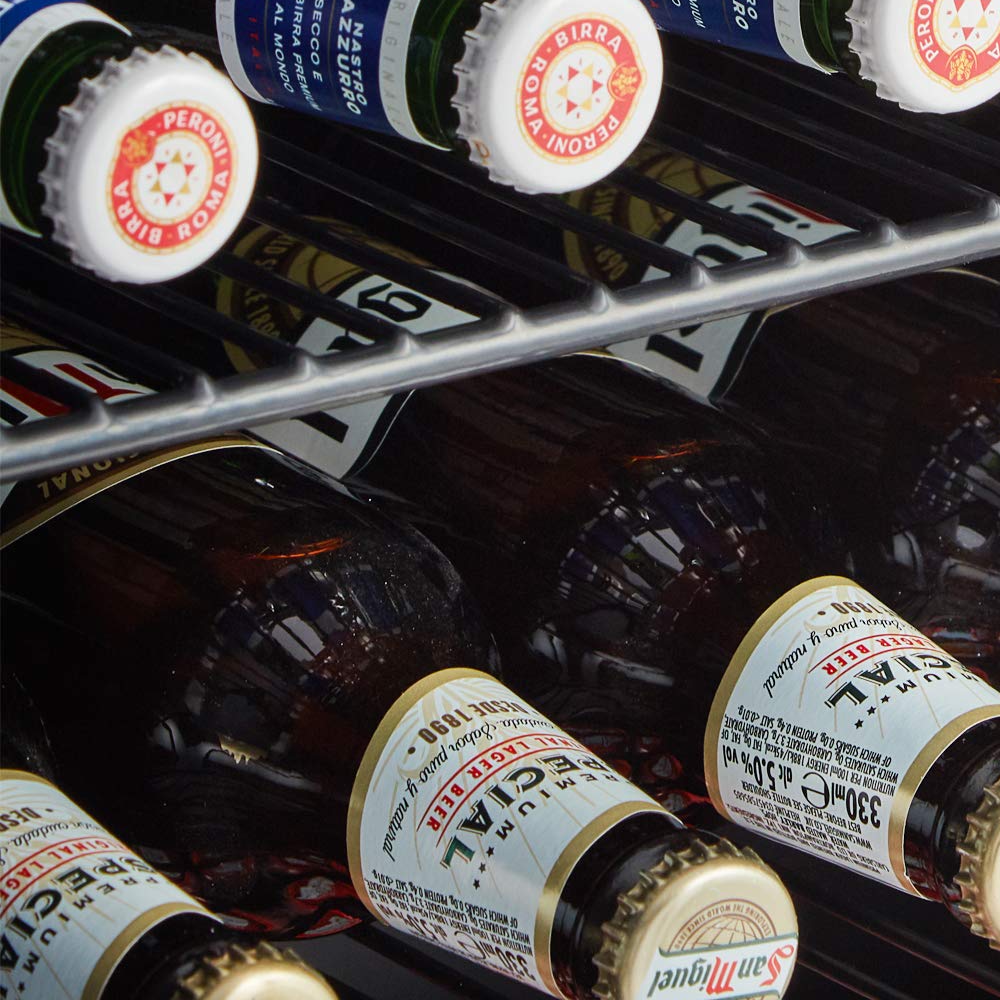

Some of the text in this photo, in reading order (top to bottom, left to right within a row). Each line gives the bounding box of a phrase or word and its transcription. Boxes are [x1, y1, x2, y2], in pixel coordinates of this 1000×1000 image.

[273, 3, 283, 26] AL
[274, 32, 294, 93] MONDO
[313, 70, 322, 82] E
[351, 22, 367, 106] NASTRO
[524, 22, 621, 155] BIRRA PERONI ROMA
[114, 110, 229, 245] BIRRA PERONI ROMA
[763, 646, 808, 698] natural
[822, 645, 870, 676] BEER
[418, 710, 467, 745] 1890
[722, 744, 739, 769] vol
[426, 736, 530, 832] LAGER BEER
[382, 800, 410, 862] natural
[648, 944, 795, 998] San Miguel
